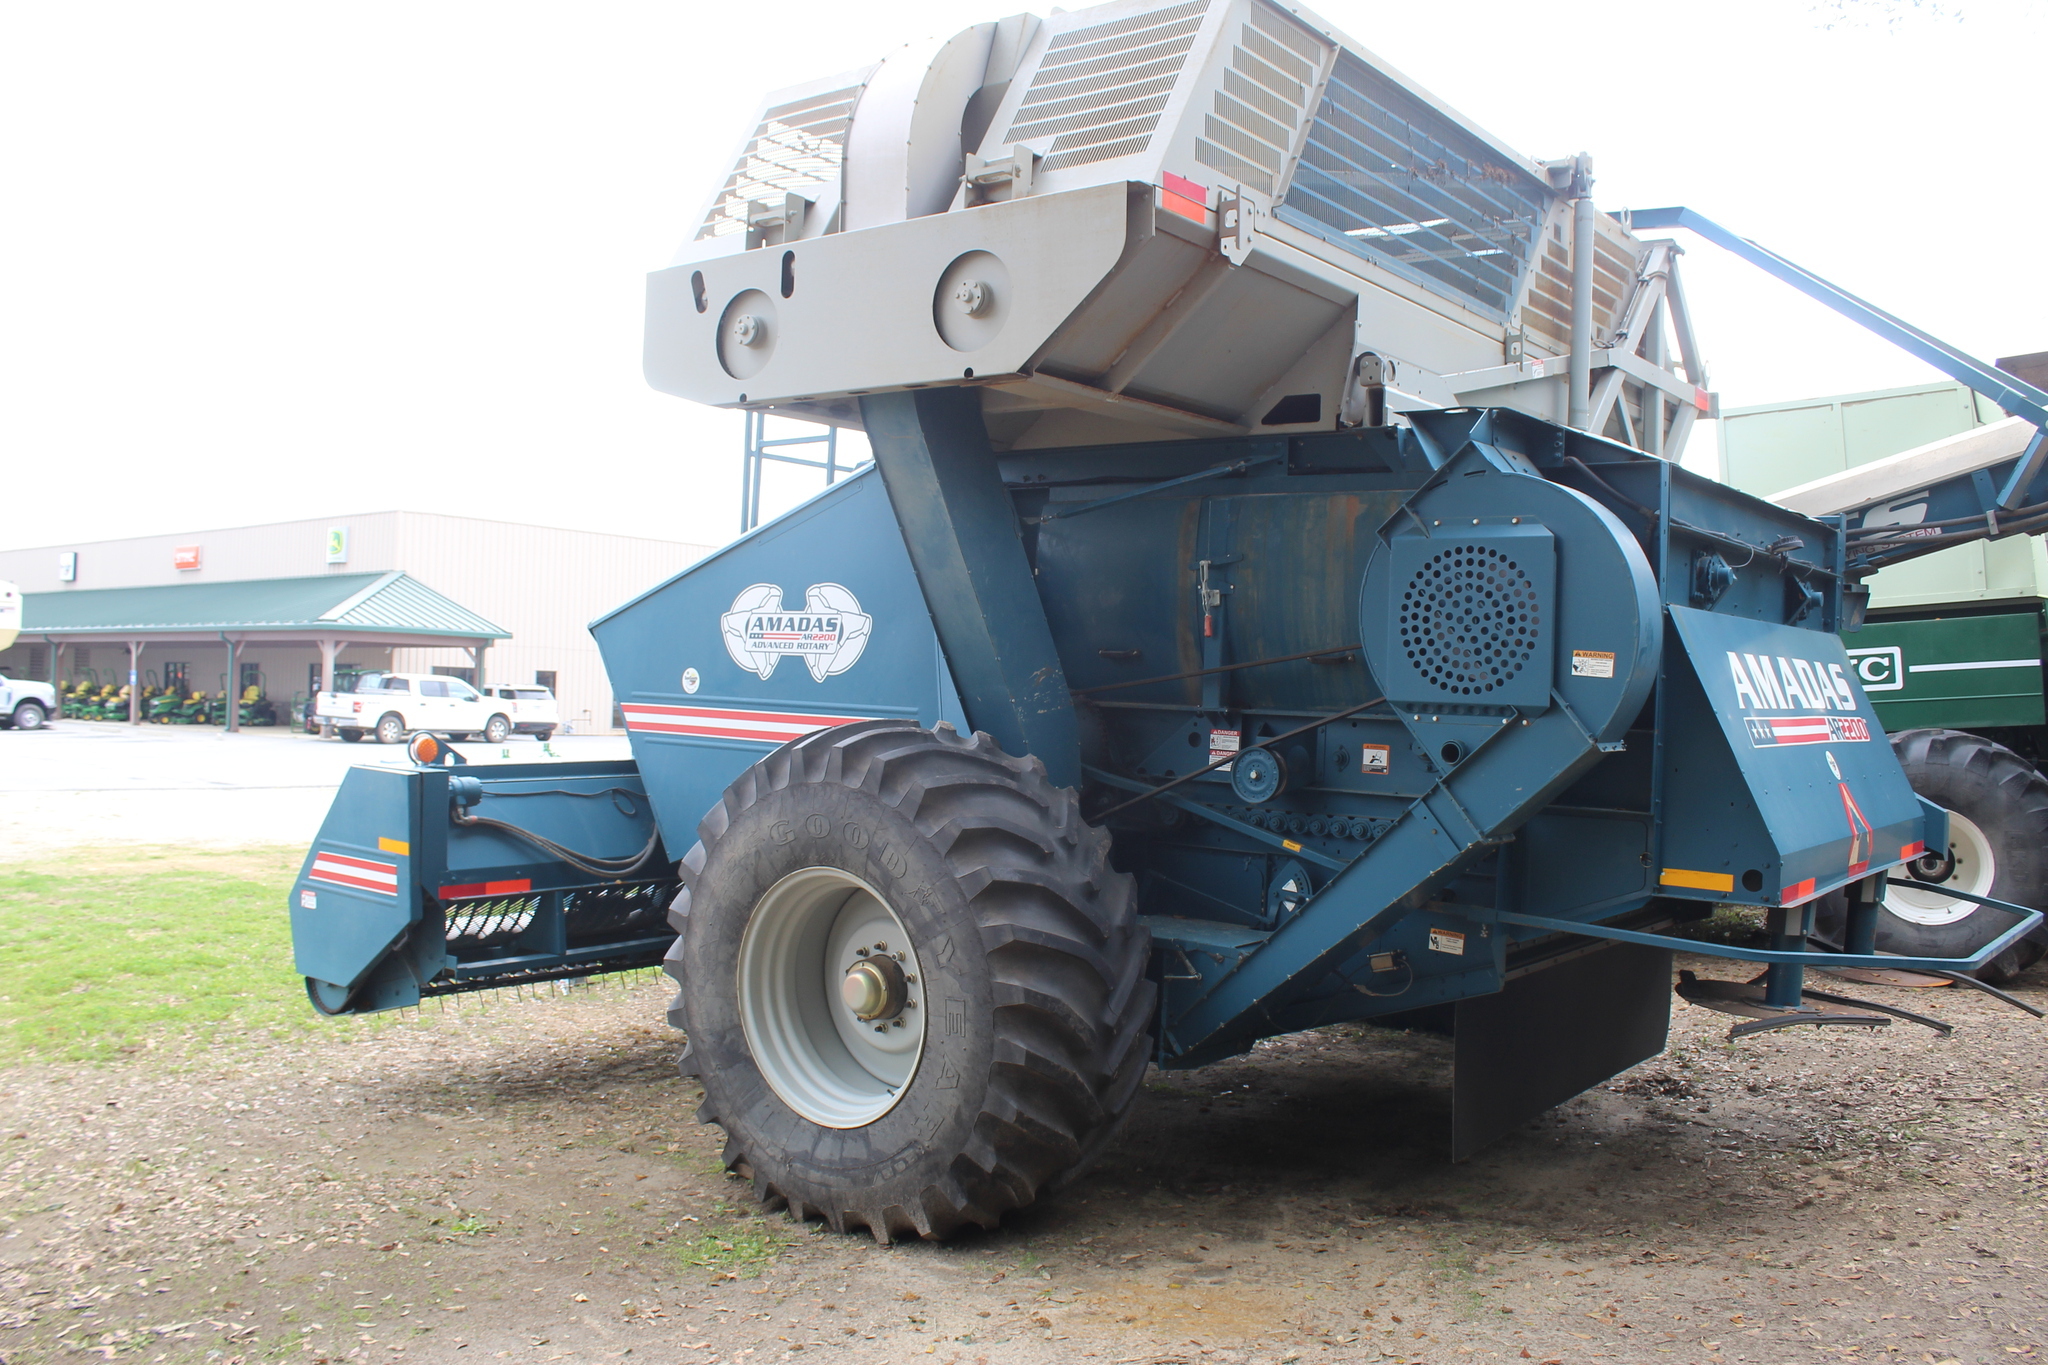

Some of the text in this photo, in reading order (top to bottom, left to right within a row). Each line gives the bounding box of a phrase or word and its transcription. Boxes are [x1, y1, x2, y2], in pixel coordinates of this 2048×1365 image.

[750, 617, 839, 632] AMADAS
[801, 633, 836, 641] AR2200
[751, 641, 830, 650] ADVANCED ROTARY
[1582, 651, 1614, 659] WARNING
[1726, 651, 1857, 711] AMADAS
[1827, 718, 1870, 741] AR2200
